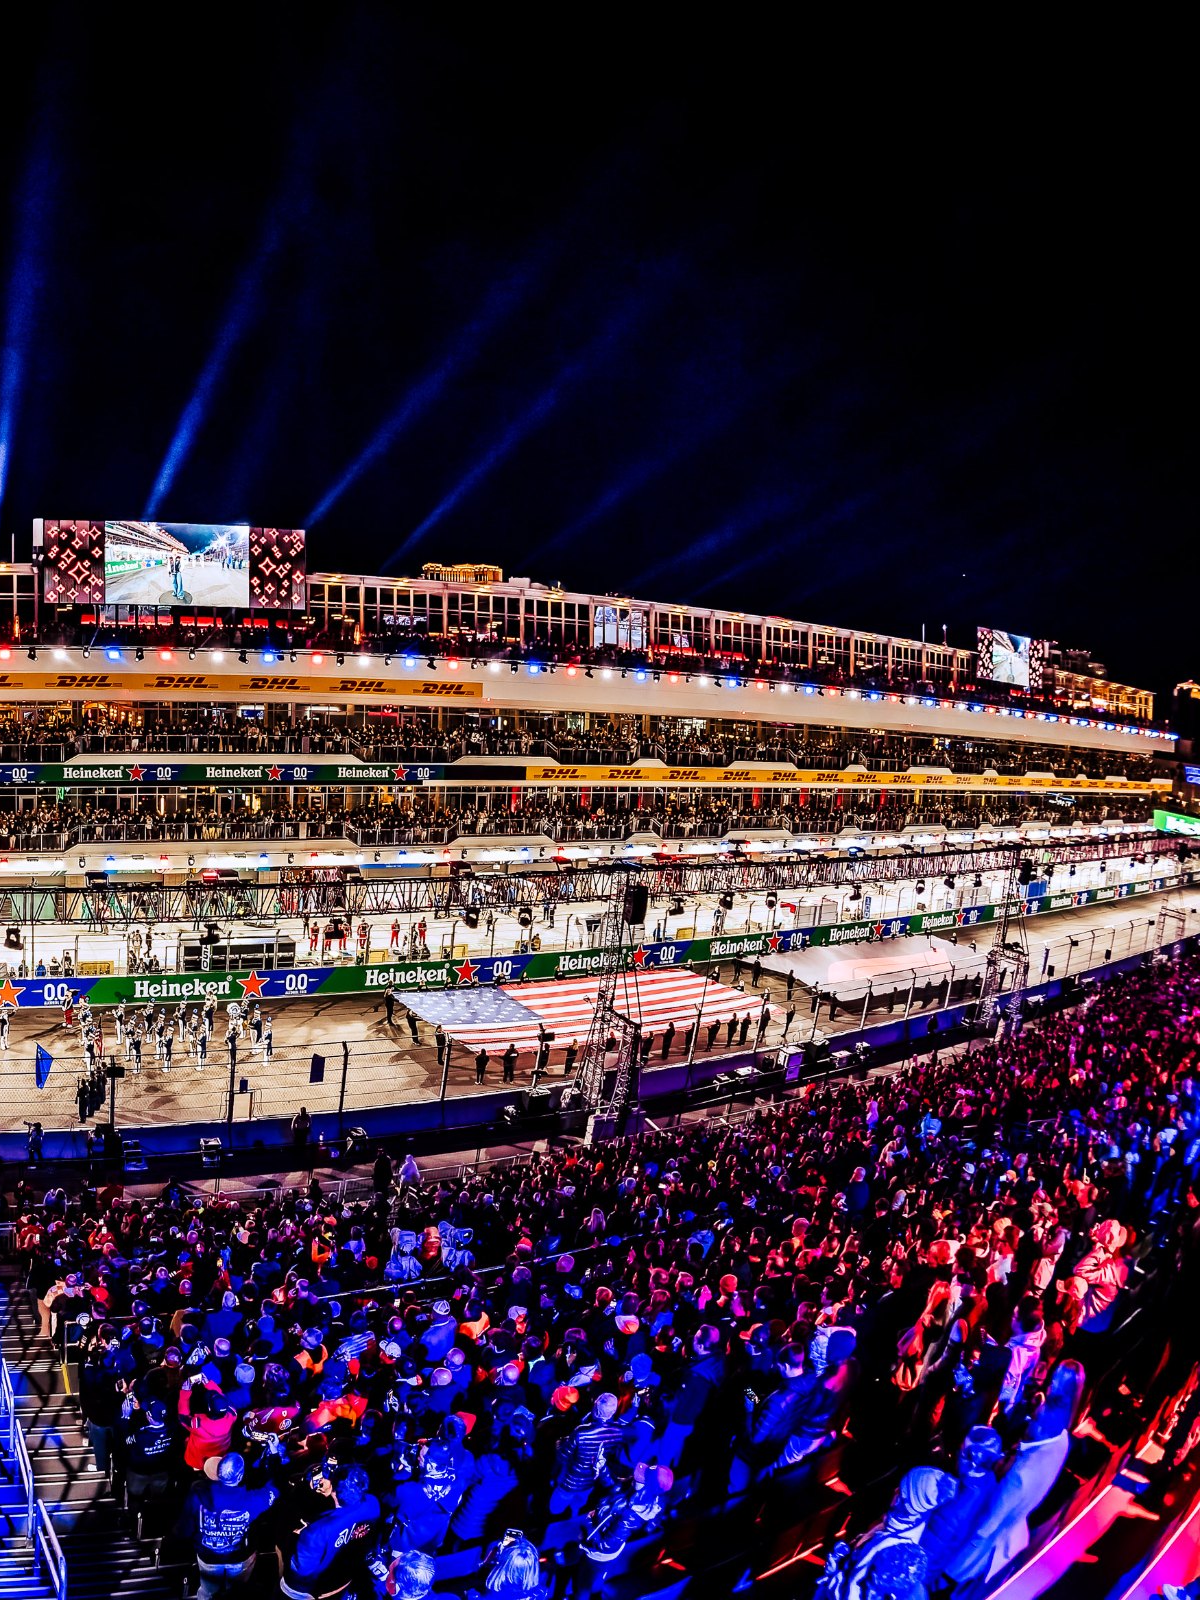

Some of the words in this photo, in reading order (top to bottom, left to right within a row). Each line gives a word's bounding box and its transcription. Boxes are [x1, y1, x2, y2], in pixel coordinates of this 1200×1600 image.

[56, 676, 112, 688] DHL
[154, 676, 208, 688] DHL
[249, 678, 300, 690] DHL
[339, 680, 388, 692] DHL
[422, 683, 468, 695] DHL
[63, 767, 122, 779] Heineken
[206, 766, 262, 778] Heineken
[338, 767, 388, 778] Heineken
[541, 768, 580, 778] DHL
[608, 770, 643, 779] DHL
[669, 770, 700, 780] DHL
[722, 771, 750, 780] DHL
[772, 772, 798, 781] DHL
[816, 774, 840, 782] DHL
[856, 774, 878, 782] DHL
[892, 775, 912, 783] DHL
[926, 776, 942, 784] DHL
[956, 776, 971, 784] DHL
[922, 914, 953, 928] Heineken
[830, 926, 870, 942] Heineken
[660, 946, 676, 960] 0.0
[712, 939, 763, 956] Heineken
[365, 966, 448, 986] Heineken
[44, 983, 68, 1001] 0.0
[134, 978, 230, 998] Heineken
[286, 974, 308, 990] 0.0
